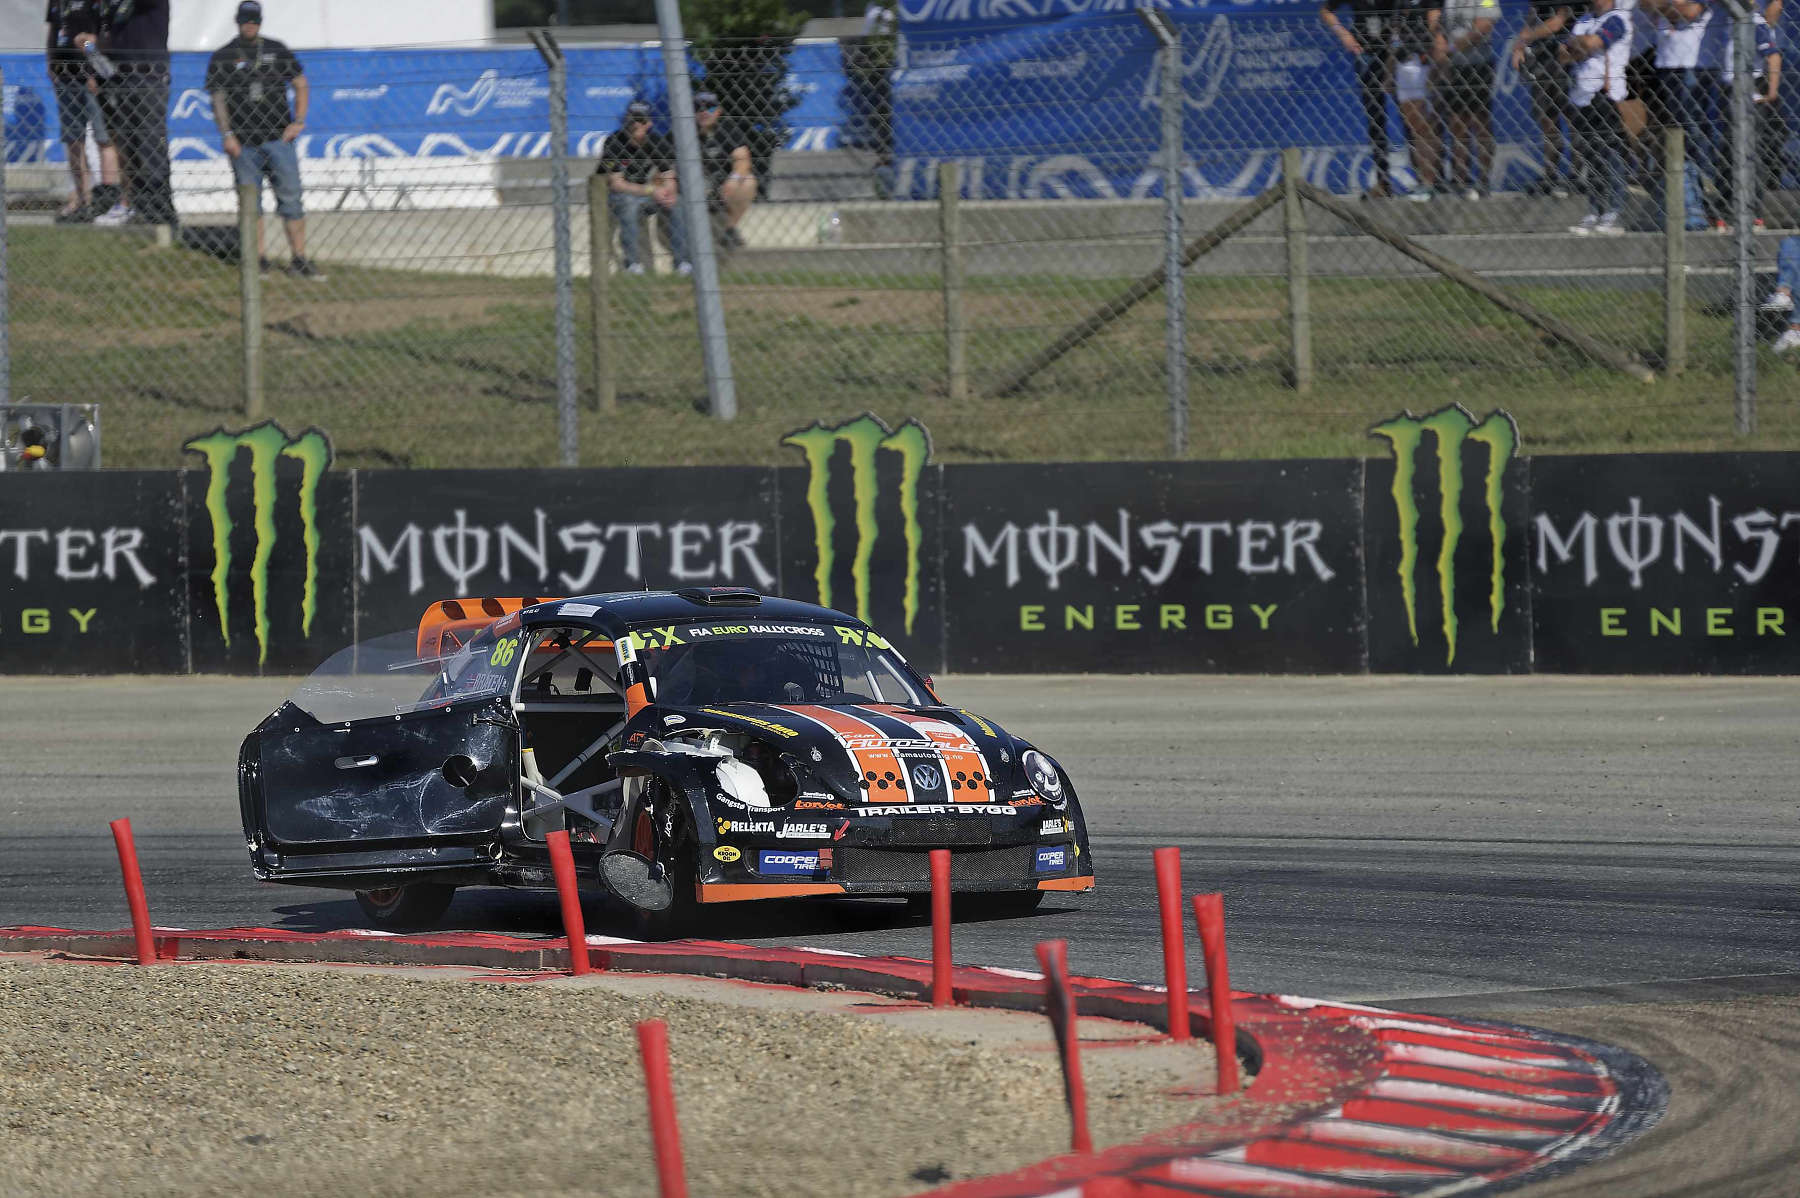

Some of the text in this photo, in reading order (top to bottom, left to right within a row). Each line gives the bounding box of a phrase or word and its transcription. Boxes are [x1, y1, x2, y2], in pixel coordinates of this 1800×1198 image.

[0, 526, 157, 589] TER
[21, 607, 98, 634] GY
[1020, 604, 1279, 631] ENERGY
[1601, 606, 1786, 637] ENER
[689, 625, 825, 637] FIA EURO RALLYCROSS
[490, 637, 518, 667] 86
[748, 804, 786, 814] Transport
[730, 821, 775, 833] RELEKTA
[775, 823, 828, 838] JARLE'S
[1038, 851, 1064, 861] COOPER
